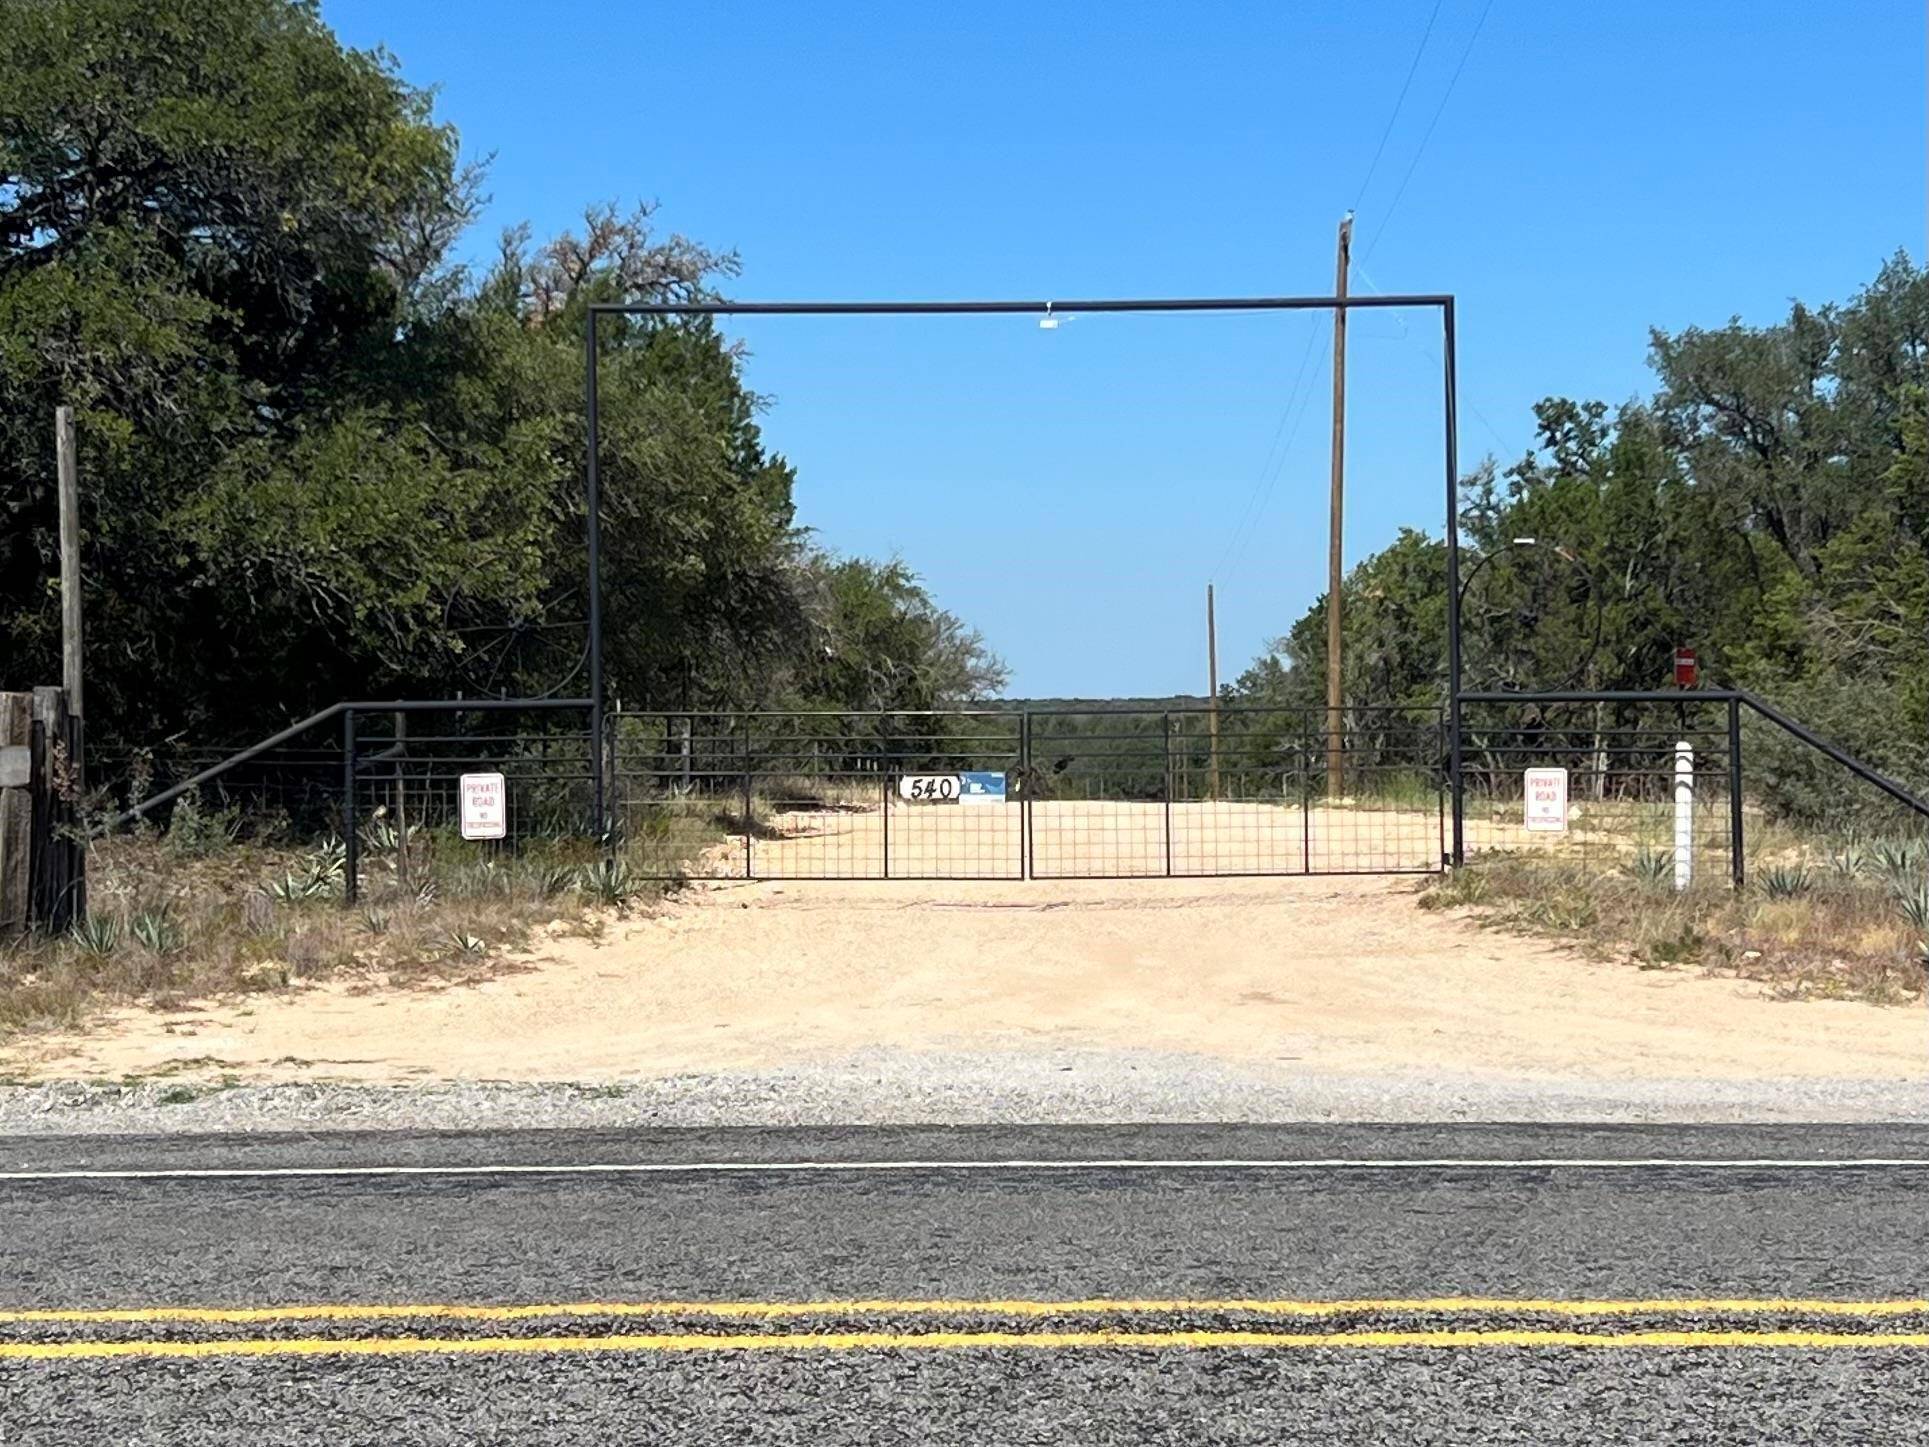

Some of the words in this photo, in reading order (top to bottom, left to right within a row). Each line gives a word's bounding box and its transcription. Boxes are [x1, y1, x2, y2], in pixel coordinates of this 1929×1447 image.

[466, 783, 499, 793] PRIVATE
[911, 778, 952, 799] 540
[1535, 791, 1557, 801] ROAD
